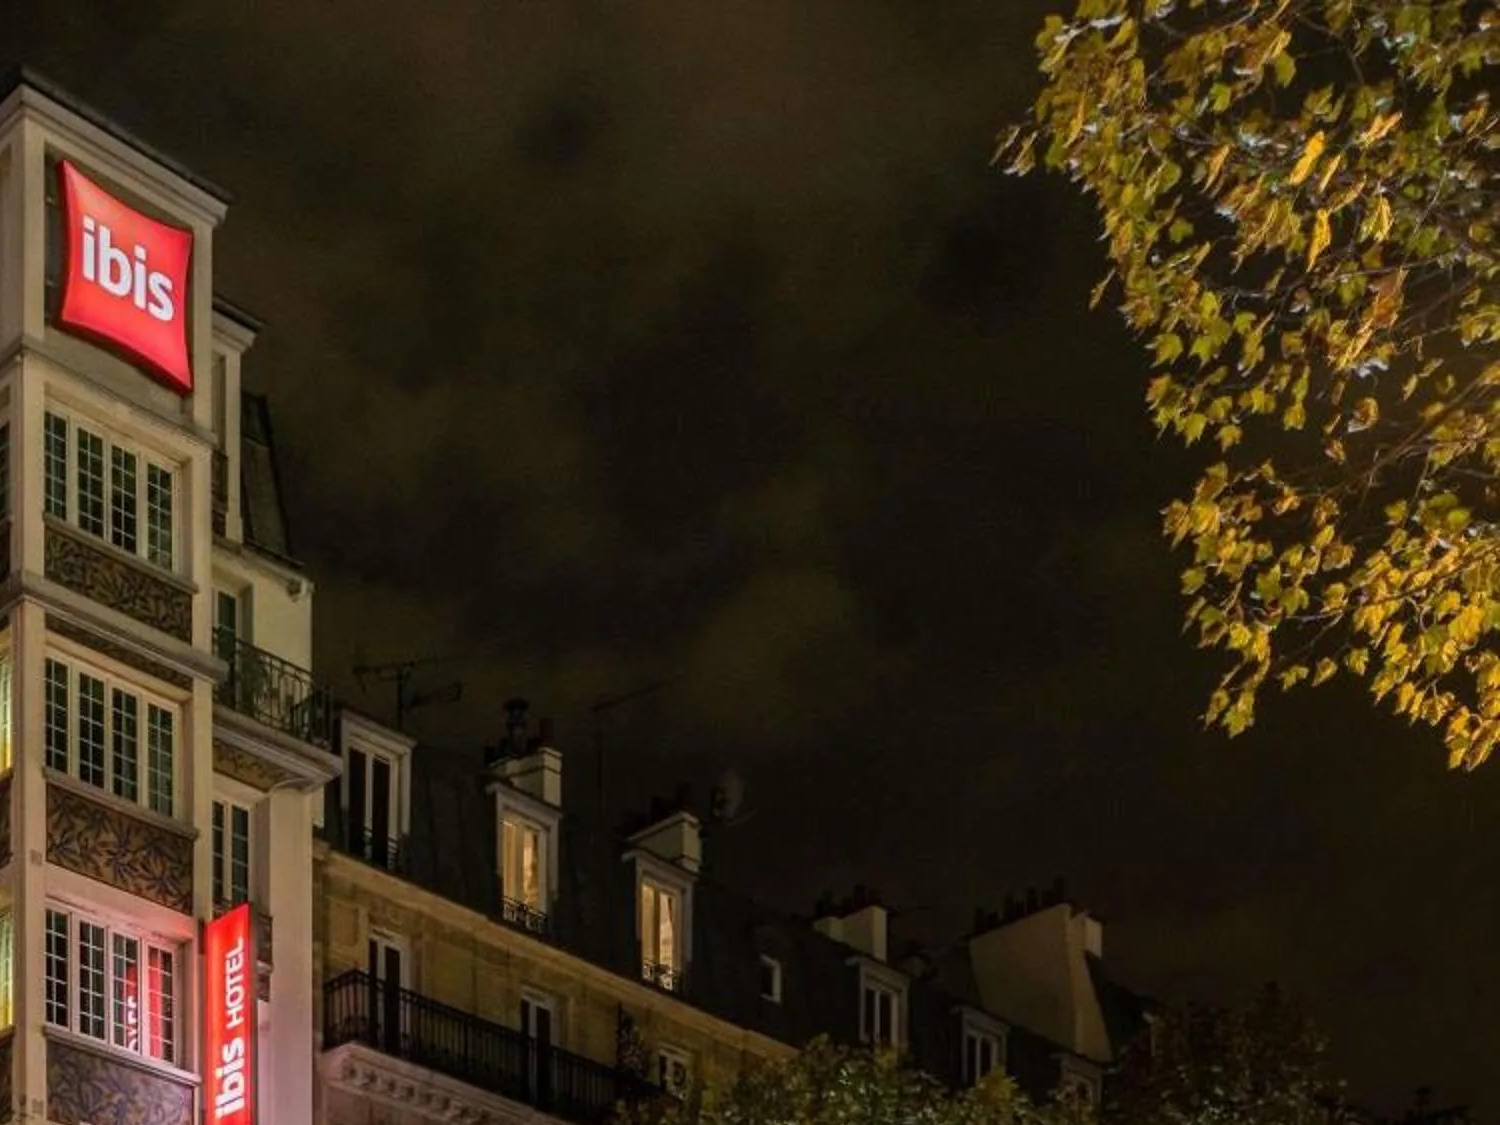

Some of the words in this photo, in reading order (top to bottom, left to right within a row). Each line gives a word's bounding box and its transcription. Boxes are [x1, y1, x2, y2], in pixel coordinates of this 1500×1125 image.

[82, 215, 174, 321] ibis
[226, 937, 245, 1030] HOTEL
[215, 1036, 245, 1119] ibis
